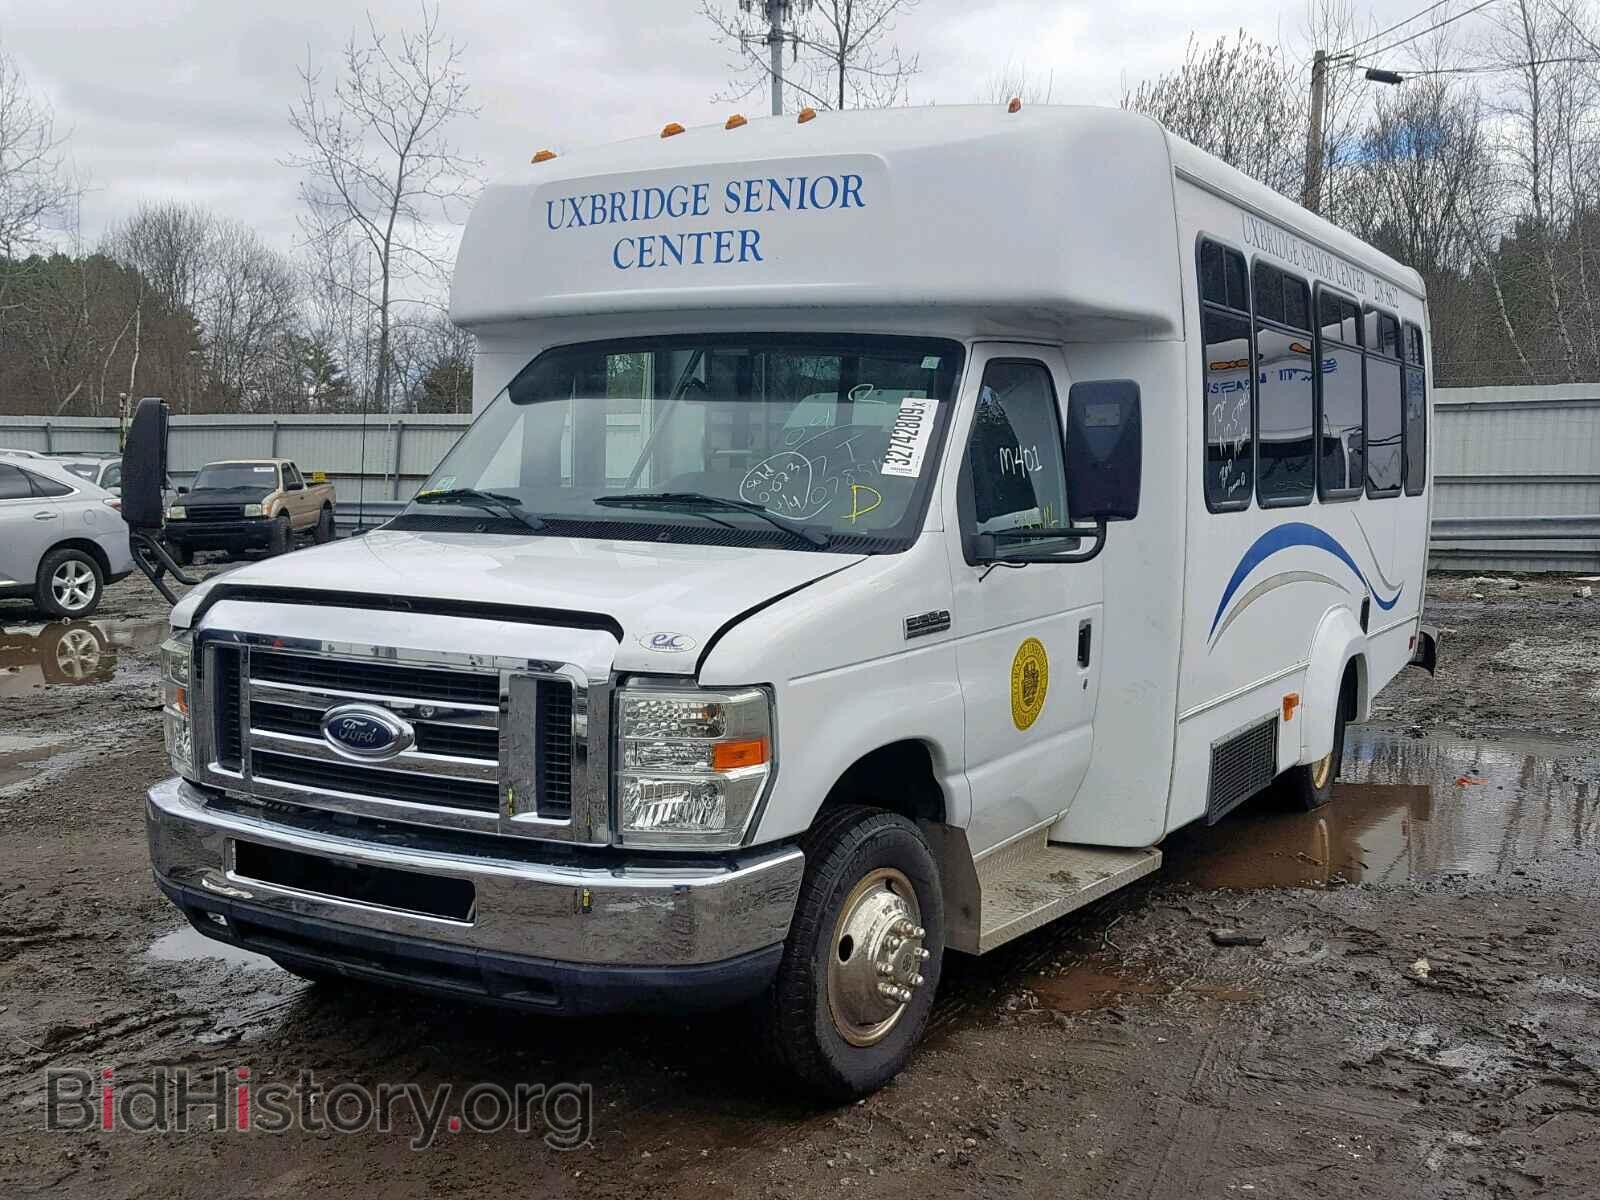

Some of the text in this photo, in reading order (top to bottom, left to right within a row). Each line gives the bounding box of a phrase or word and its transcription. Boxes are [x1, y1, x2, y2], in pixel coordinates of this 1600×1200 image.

[546, 174, 866, 229] UXBRIDGE SENIOR
[612, 229, 764, 270] CENTER
[1241, 212, 1300, 266] UXBRIDGE
[1301, 242, 1335, 282] SENIOR
[1336, 259, 1367, 294] CENTER
[884, 407, 925, 466] 32742809
[338, 718, 378, 744] Ford
